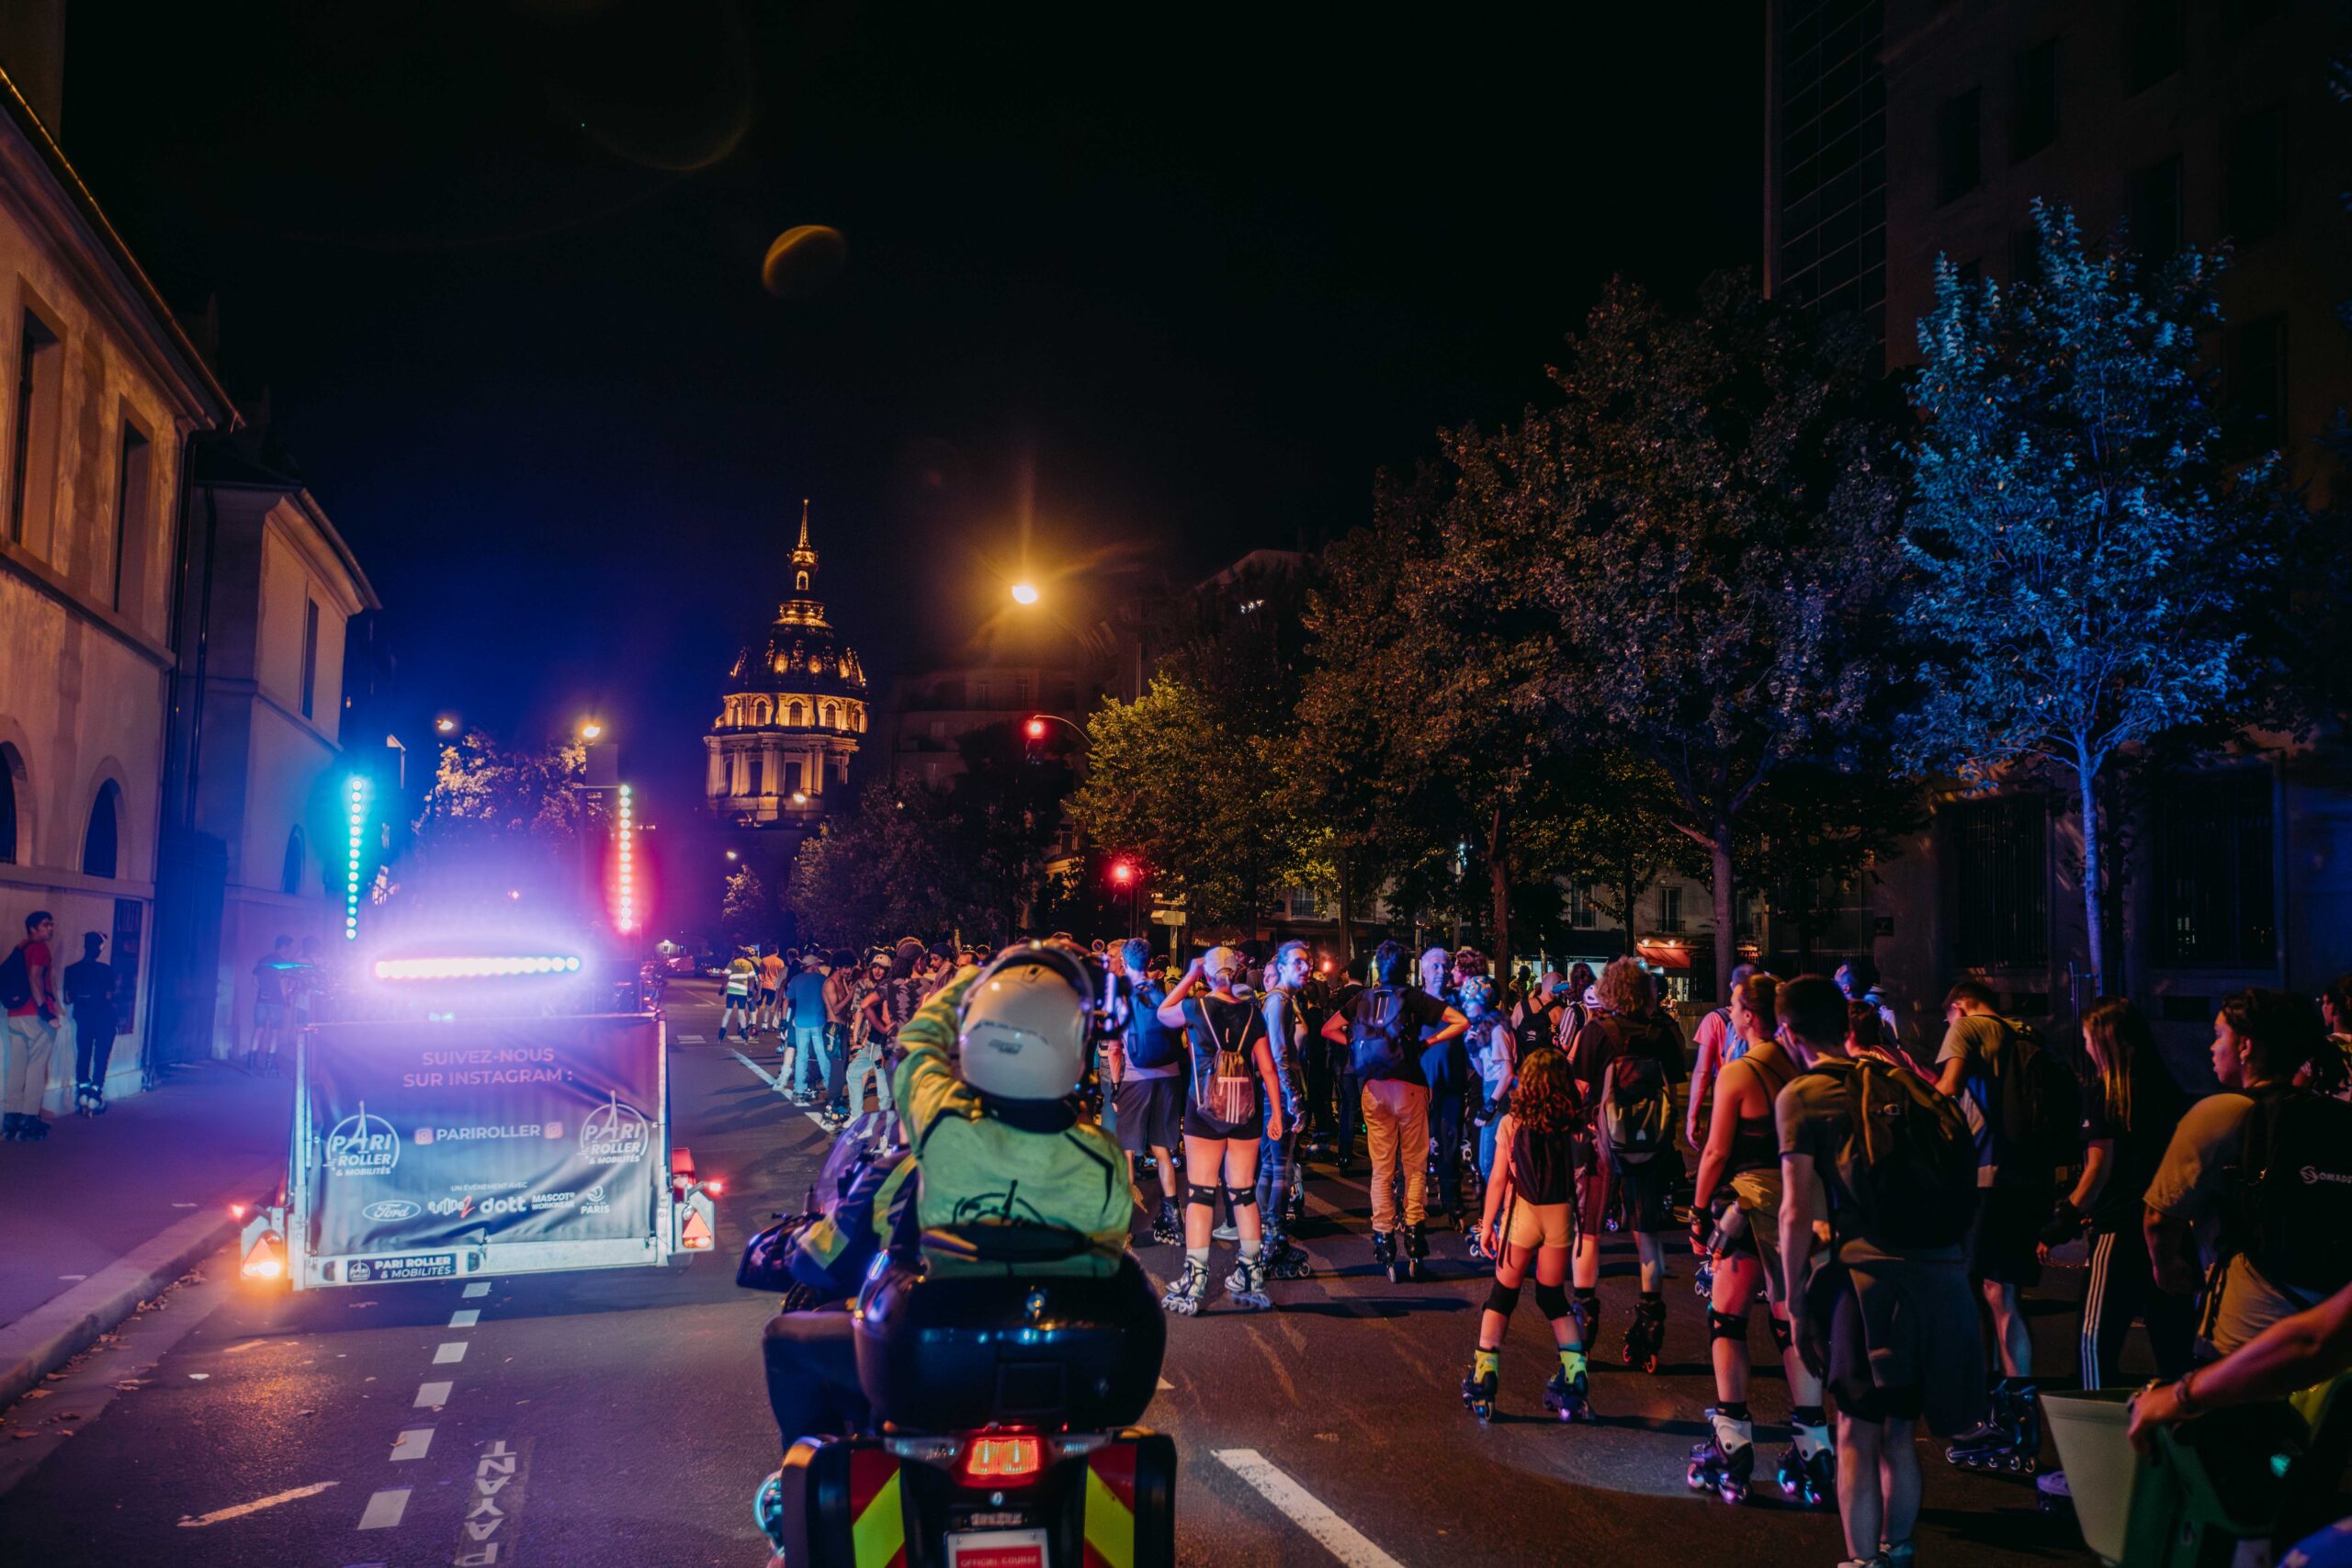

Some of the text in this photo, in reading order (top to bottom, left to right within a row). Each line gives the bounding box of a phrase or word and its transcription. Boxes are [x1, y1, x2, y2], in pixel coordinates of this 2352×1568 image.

[422, 1047, 555, 1066] SUIVEZ-NOUS
[403, 1072, 444, 1088] SUR
[448, 1068, 562, 1086] INSTAGRAM
[436, 1124, 541, 1141] PARIROLLER
[590, 1142, 641, 1156] ROLLER
[337, 1153, 392, 1167] ROLLER
[373, 1203, 410, 1219] Ford
[480, 1197, 527, 1213] dott
[531, 1201, 575, 1210] WORKWEAR
[581, 1205, 610, 1214] PARIS
[374, 1257, 451, 1270] PARI ROLLER
[391, 1266, 451, 1278] MOBILITÉS
